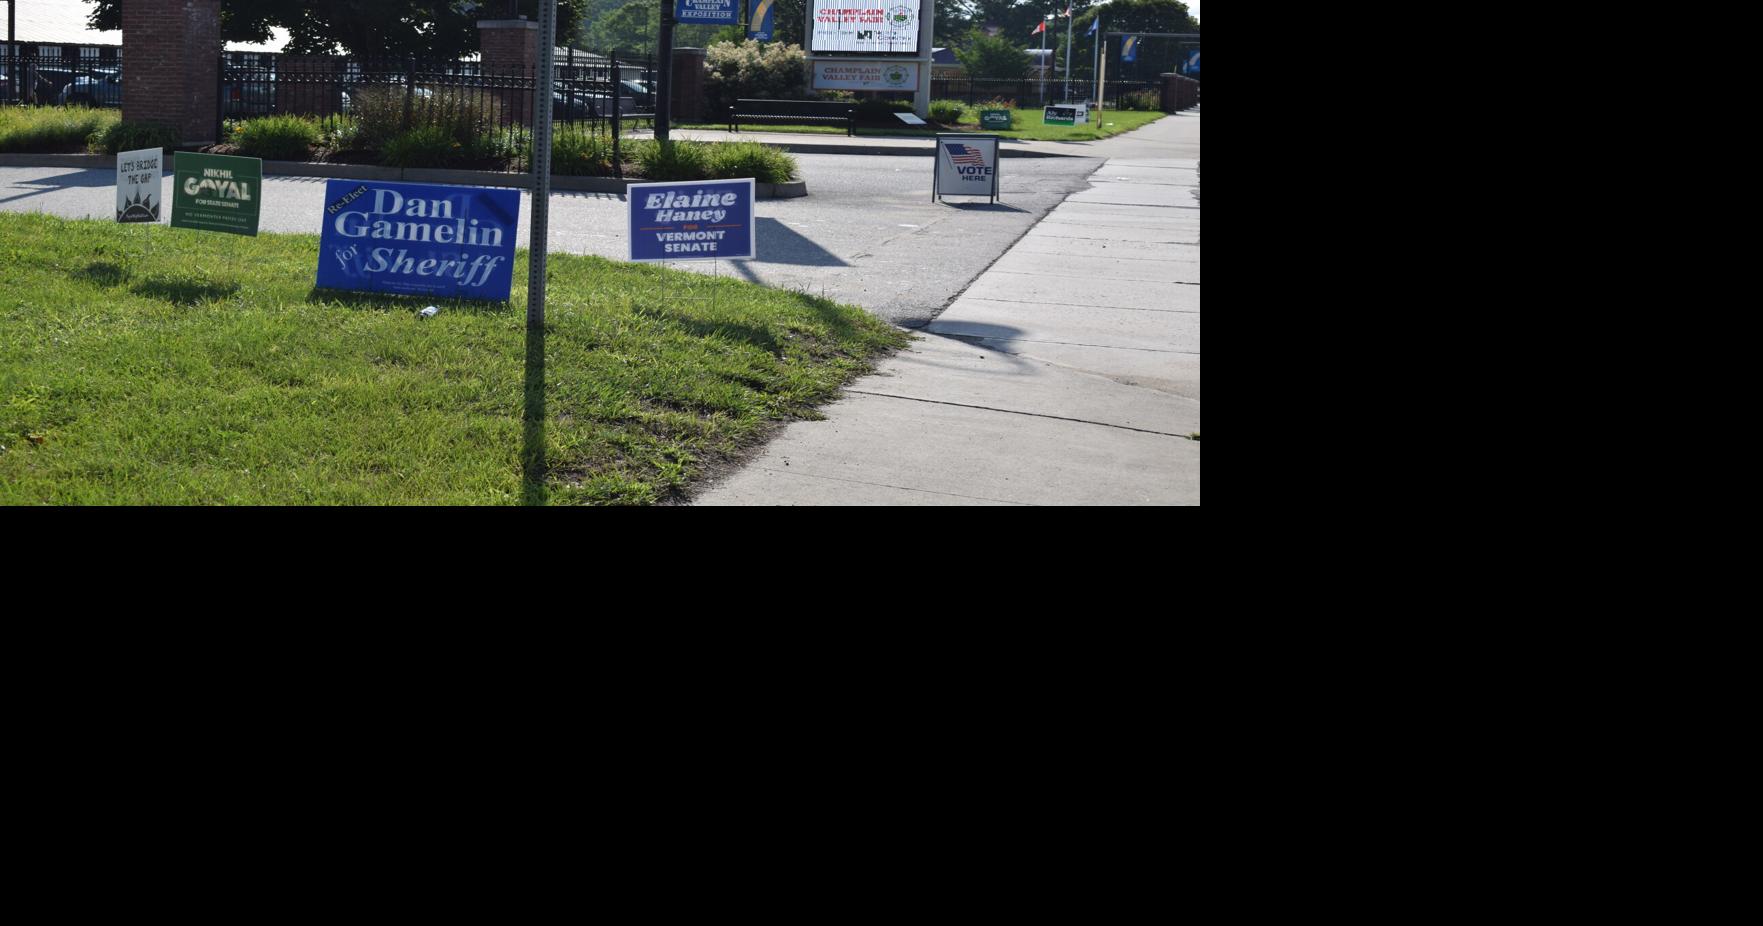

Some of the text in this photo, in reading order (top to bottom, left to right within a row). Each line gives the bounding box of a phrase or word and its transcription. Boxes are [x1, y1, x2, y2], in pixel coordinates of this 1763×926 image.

[682, 10, 732, 18] EXPOSITION
[120, 158, 158, 172] LET'S BRIDGE
[957, 166, 992, 175] VOTE
[128, 172, 152, 185] THE GAP
[203, 168, 233, 178] NIKHIL
[184, 177, 251, 200] GOYAL
[327, 185, 368, 214] Re-Elect
[370, 188, 453, 218] Dan
[644, 190, 737, 209] Elaine
[655, 209, 726, 222] Haney
[334, 211, 502, 246] Gamelin
[656, 230, 726, 242] VERMONT
[664, 242, 718, 253] SENATE
[335, 243, 358, 271] for
[363, 247, 506, 287] Sheriff
